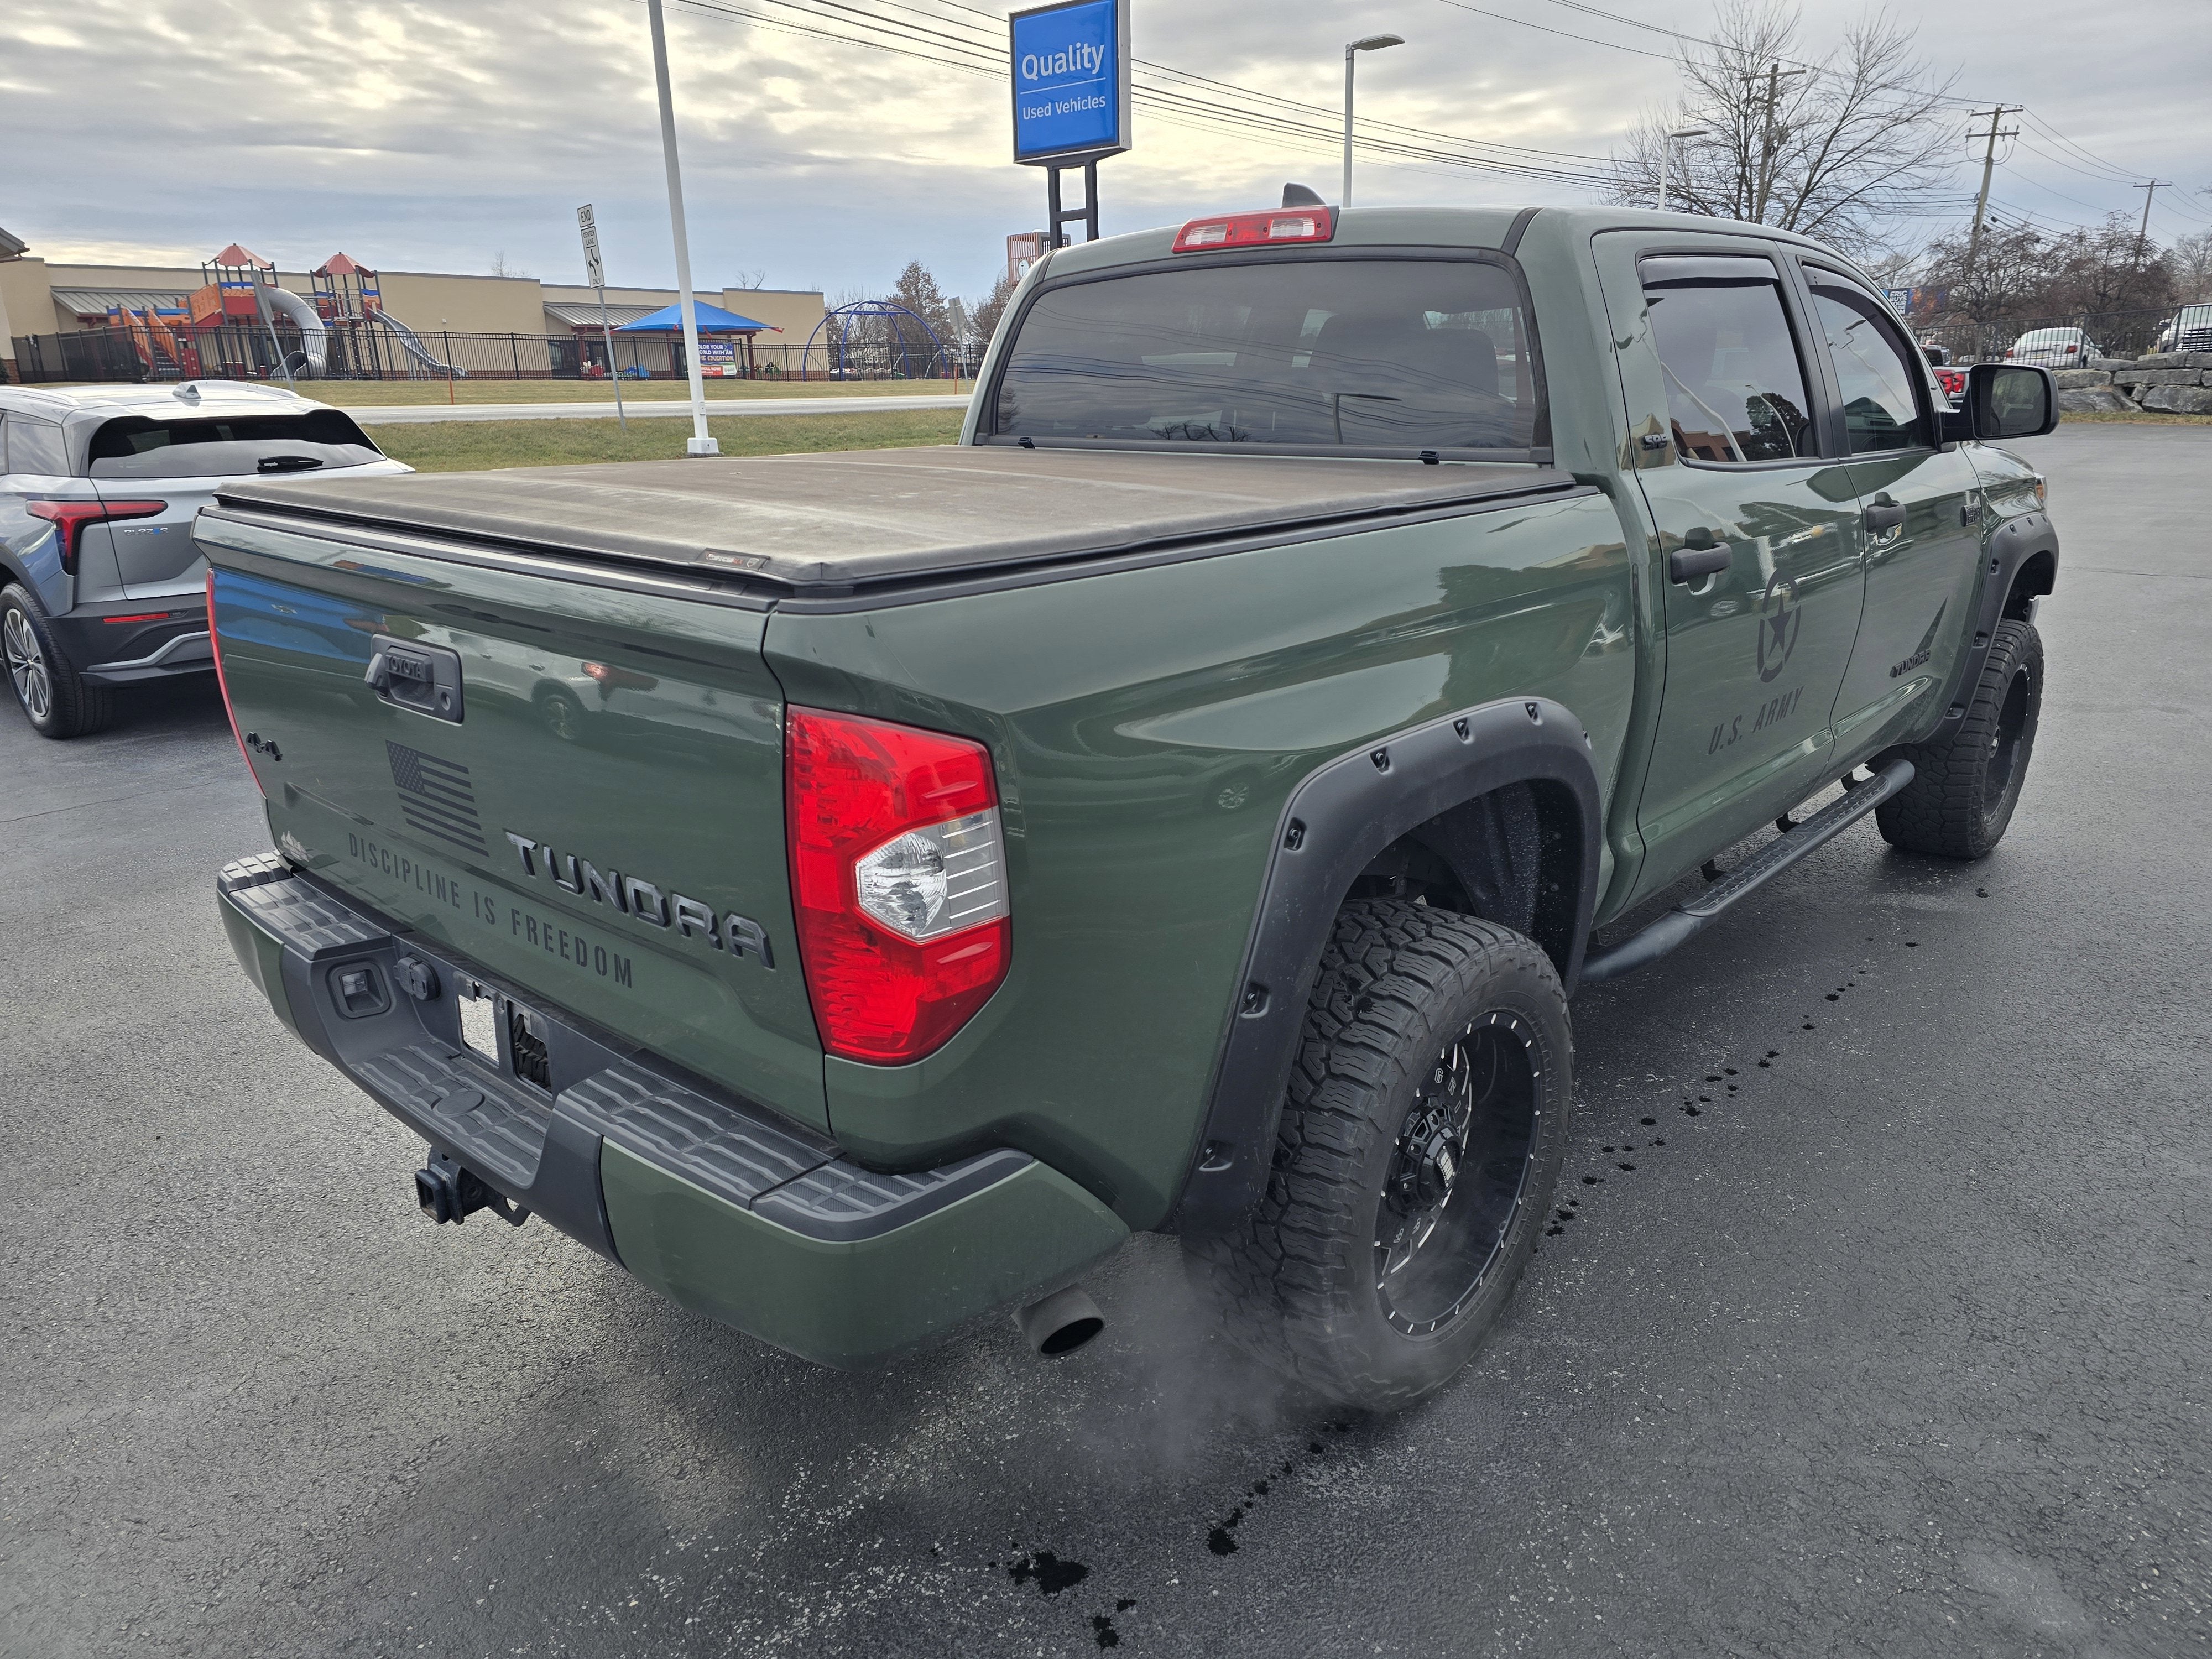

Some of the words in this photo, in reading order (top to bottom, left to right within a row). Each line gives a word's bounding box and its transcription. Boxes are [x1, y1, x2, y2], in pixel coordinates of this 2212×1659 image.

[1022, 42, 1104, 81] Quality
[1023, 102, 1051, 120] Used
[1055, 96, 1106, 114] Vehicles
[580, 209, 591, 223] END
[583, 229, 595, 238] CENTER
[386, 655, 425, 681] TOYOTA
[1890, 649, 1931, 677] TUNDRA
[1709, 714, 1743, 755] U.S.
[1752, 685, 1804, 733] ARMY
[349, 832, 460, 909] DISCIPLINE
[474, 891, 495, 925] IS
[511, 908, 632, 988] FREEDOM
[505, 831, 775, 969] TUNDRA
